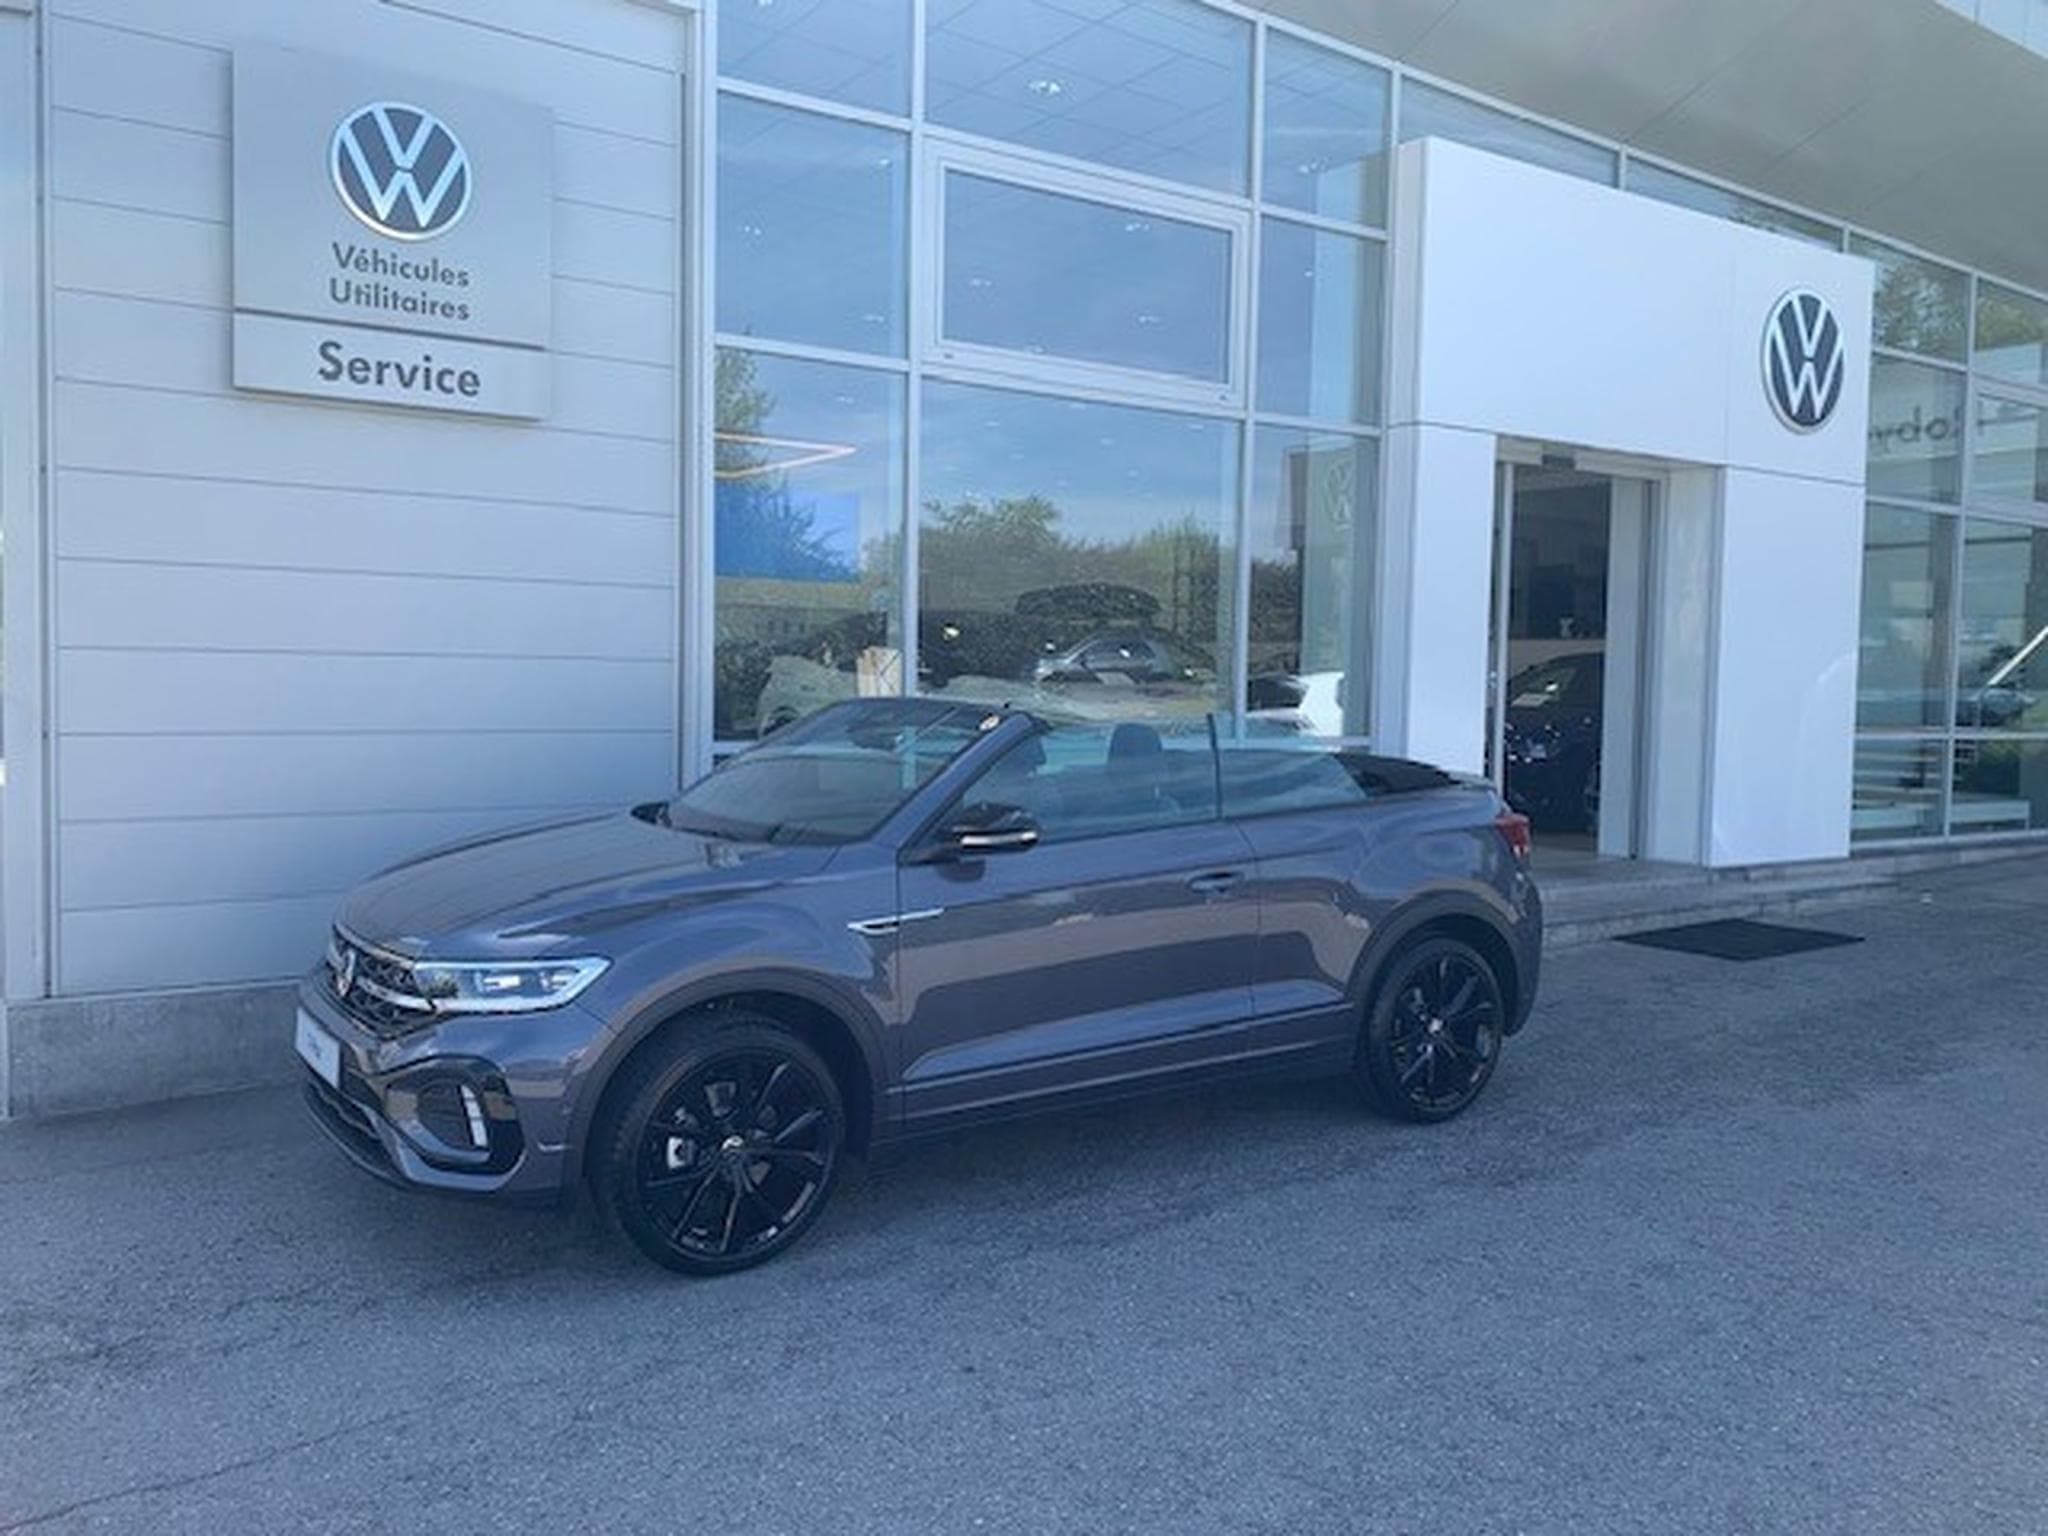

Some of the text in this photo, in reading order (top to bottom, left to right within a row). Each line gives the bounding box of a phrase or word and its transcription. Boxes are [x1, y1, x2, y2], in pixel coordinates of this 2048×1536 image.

[331, 241, 470, 287] Véhicules
[329, 277, 470, 320] Utilitaires
[317, 340, 481, 397] Service
